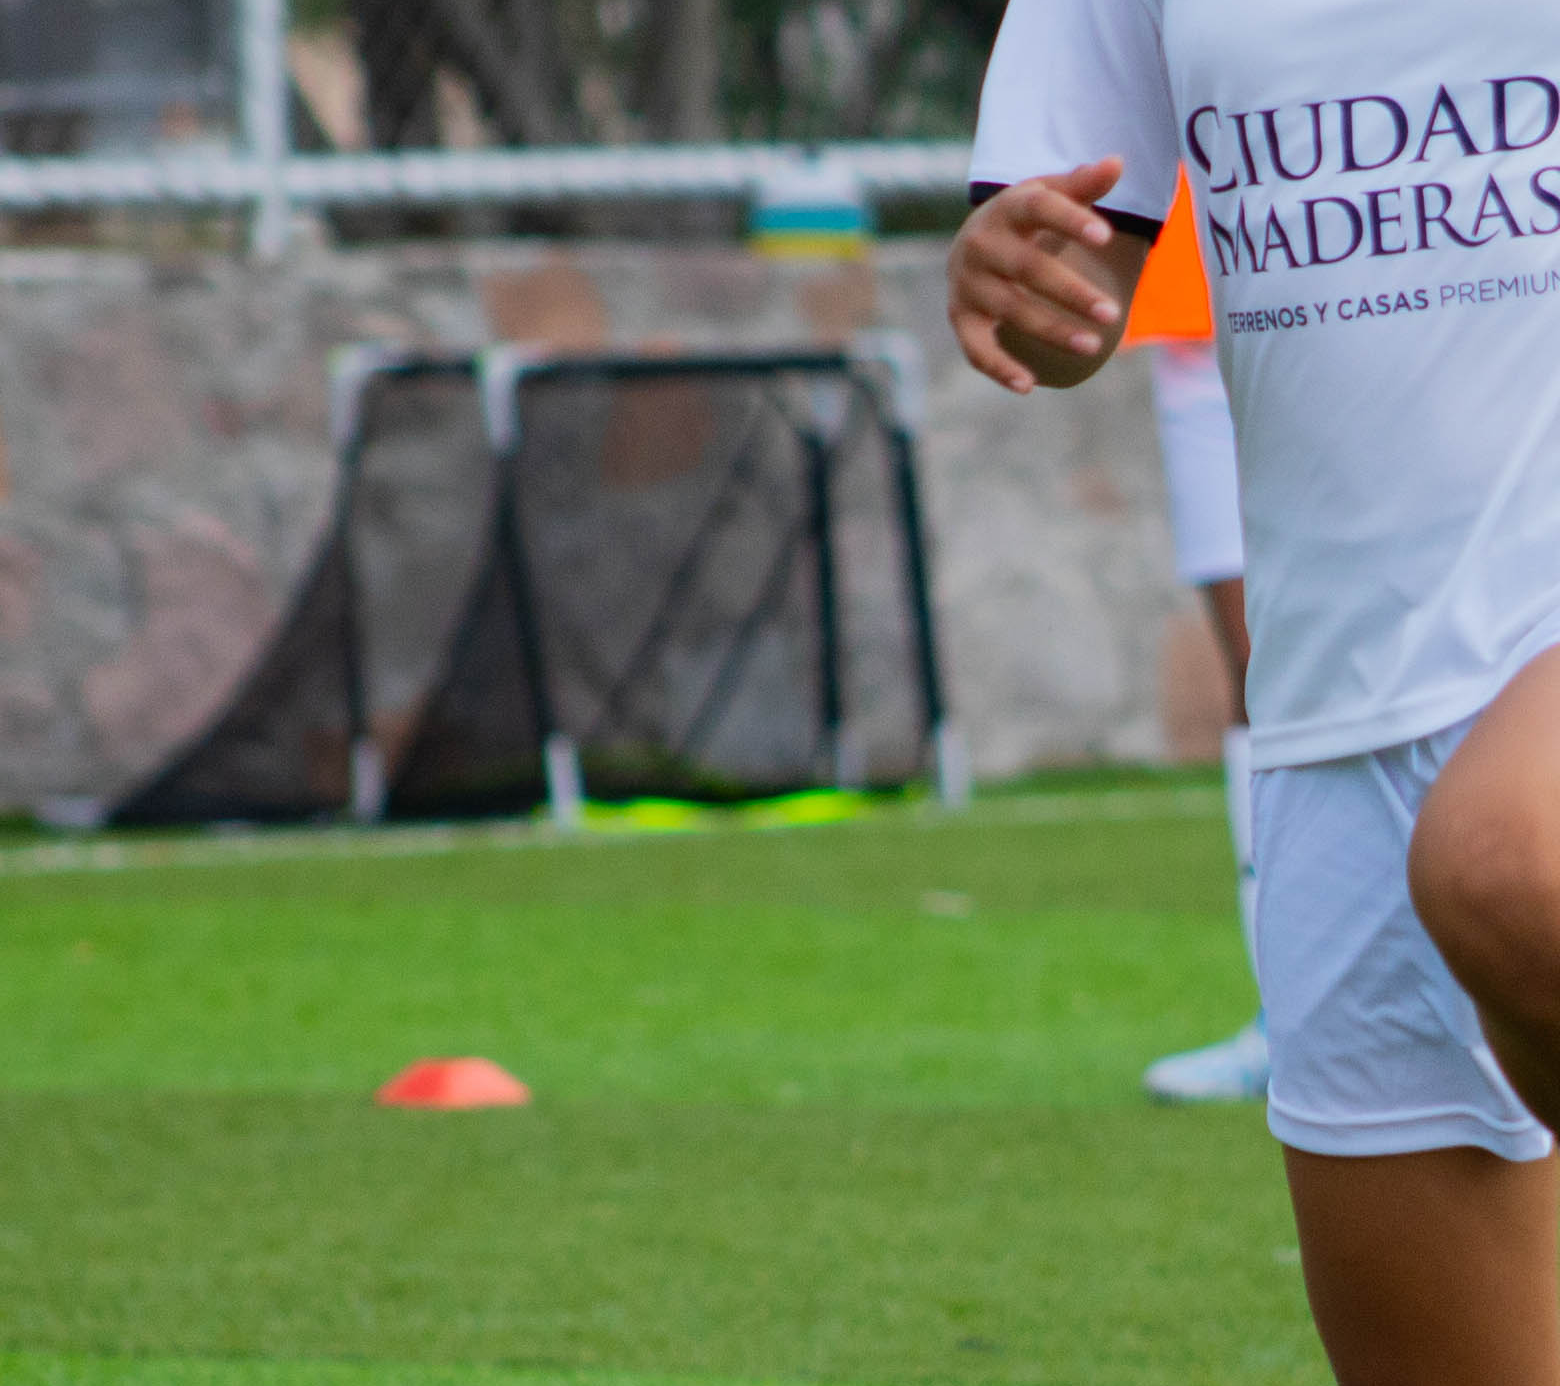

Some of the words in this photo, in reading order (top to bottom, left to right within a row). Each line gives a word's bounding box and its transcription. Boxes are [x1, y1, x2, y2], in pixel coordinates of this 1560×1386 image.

[1185, 75, 1560, 194] CIUDAD
[1227, 306, 1309, 335] TERRENOS
[1313, 301, 1329, 324] Y
[1337, 288, 1430, 322] CASAS
